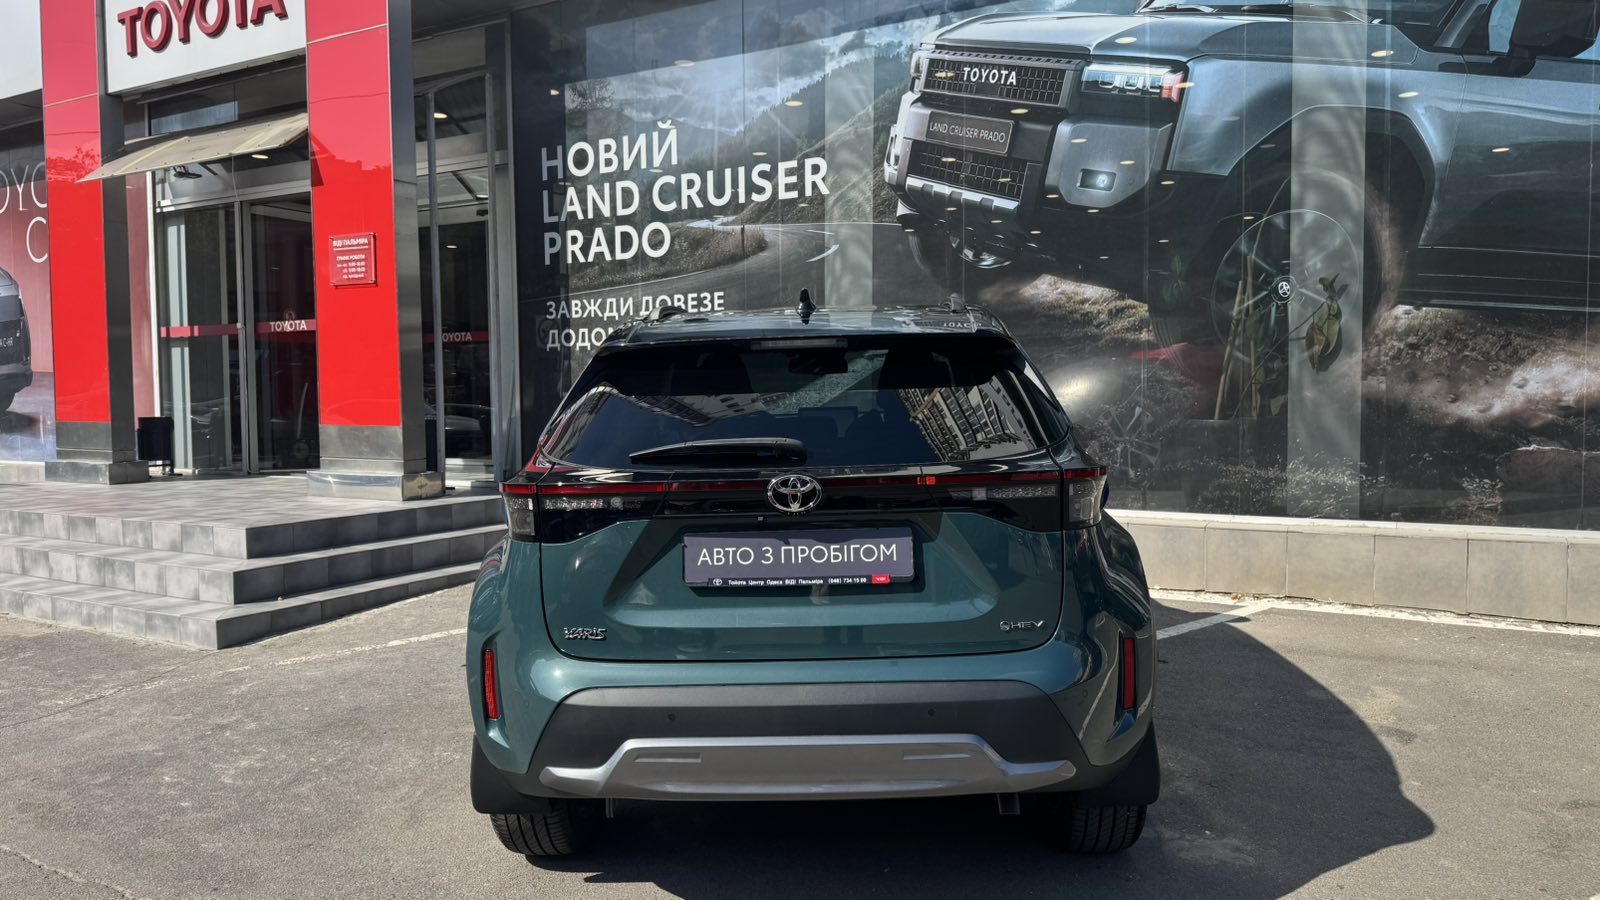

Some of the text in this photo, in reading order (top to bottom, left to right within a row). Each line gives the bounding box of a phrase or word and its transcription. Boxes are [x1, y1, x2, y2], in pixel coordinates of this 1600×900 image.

[963, 67, 1017, 85] TOYOTA
[929, 122, 1006, 143] LAND CRUISER PRADO
[541, 119, 678, 180] НОВИЙ
[542, 156, 830, 224] LAND CRUISER
[543, 221, 672, 265] PRADO
[546, 297, 634, 320] ЗАВЖДИ
[270, 320, 308, 332] TOYOTA
[442, 332, 473, 342] OYOTA
[547, 327, 614, 351] ДОДО
[697, 547, 754, 566] АВТО
[780, 543, 897, 564] ПРОБІГОМ
[1010, 620, 1044, 629] HEV
